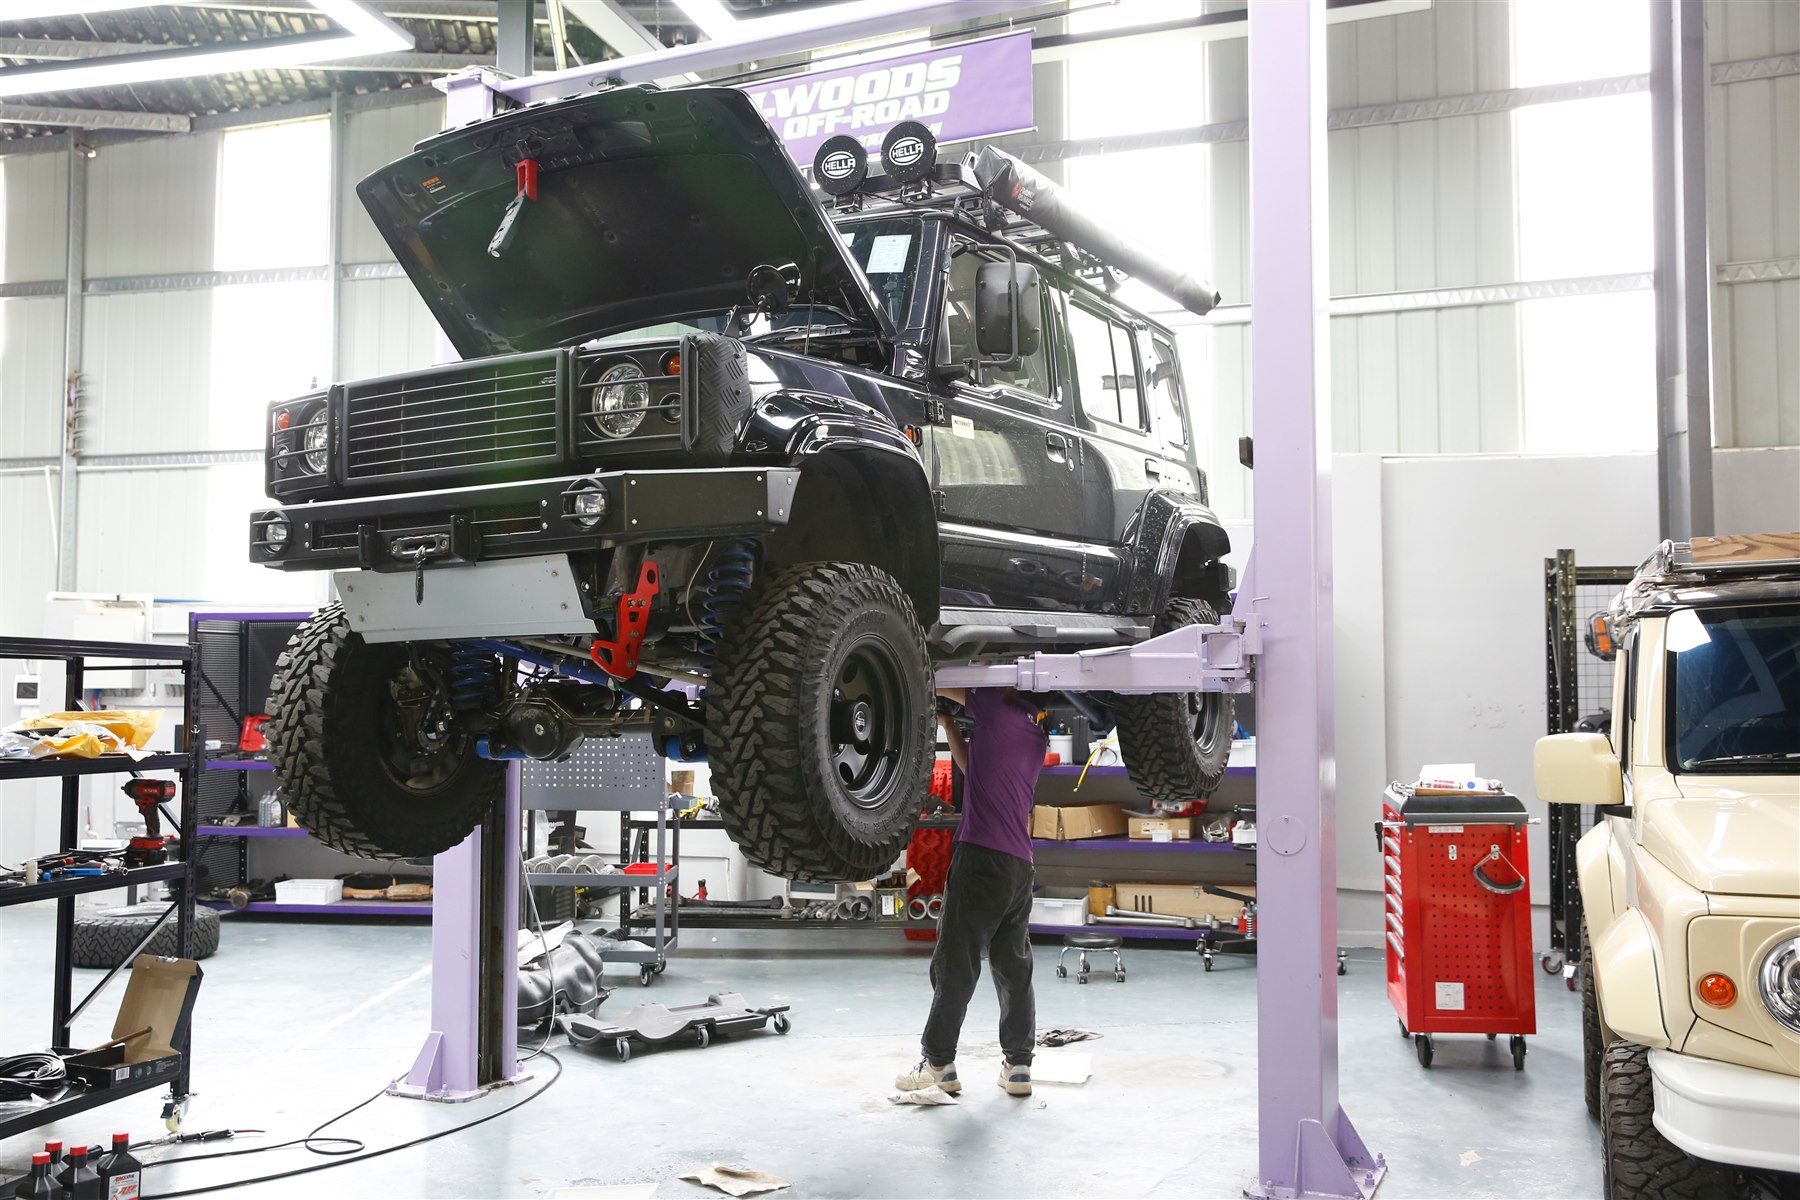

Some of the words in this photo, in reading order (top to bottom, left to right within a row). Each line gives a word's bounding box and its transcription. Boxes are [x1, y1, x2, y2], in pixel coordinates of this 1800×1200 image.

[783, 90, 950, 141] OFF-ROAD
[892, 142, 924, 159] HELLA
[824, 158, 856, 171] HELLA
